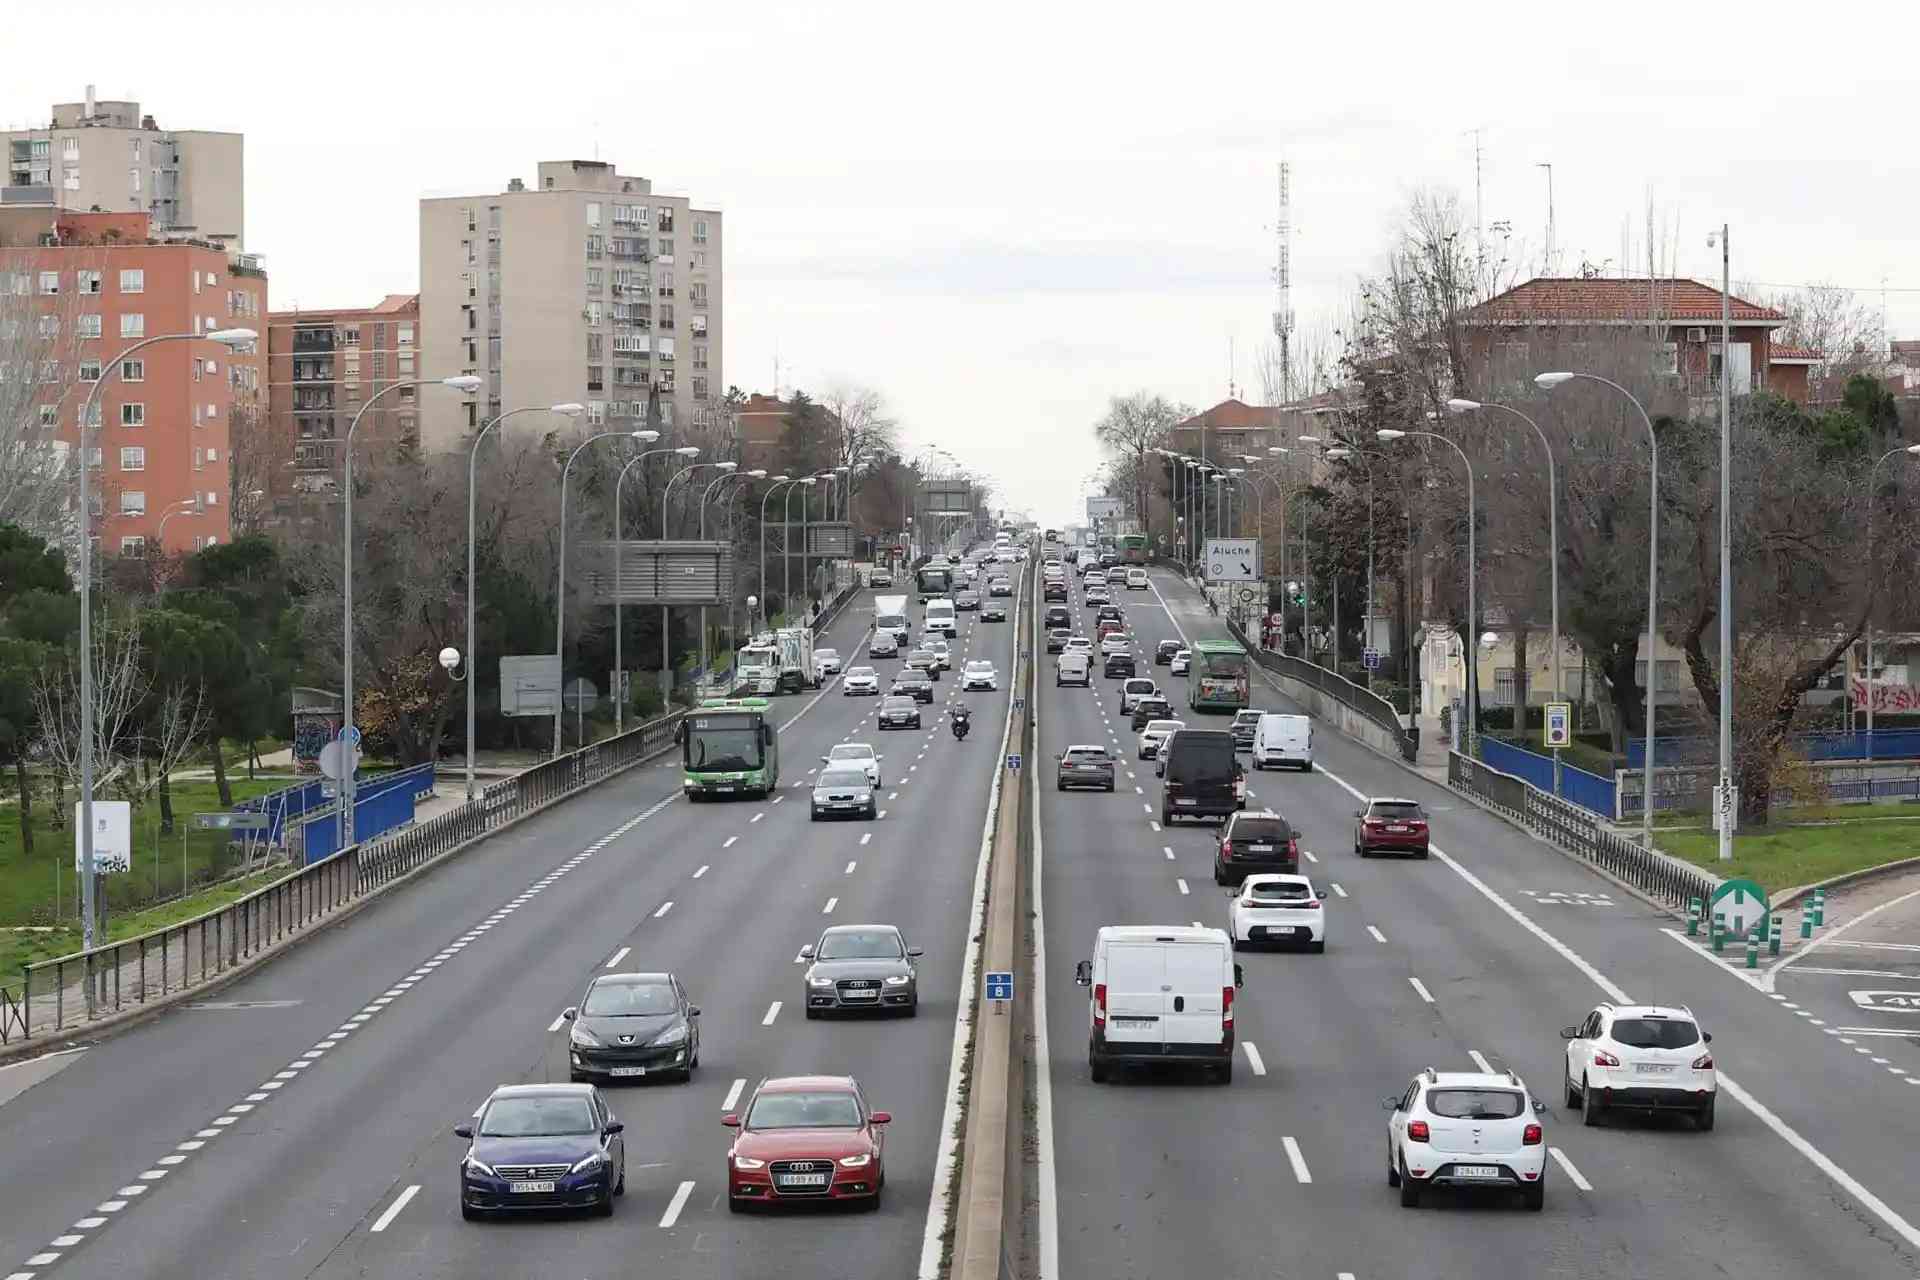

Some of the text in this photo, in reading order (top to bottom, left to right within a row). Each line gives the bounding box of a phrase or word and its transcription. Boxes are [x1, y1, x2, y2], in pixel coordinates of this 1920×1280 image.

[1213, 545, 1250, 555] Aluche
[1518, 889, 1611, 899] TAXI
[1535, 898, 1615, 906] BUS
